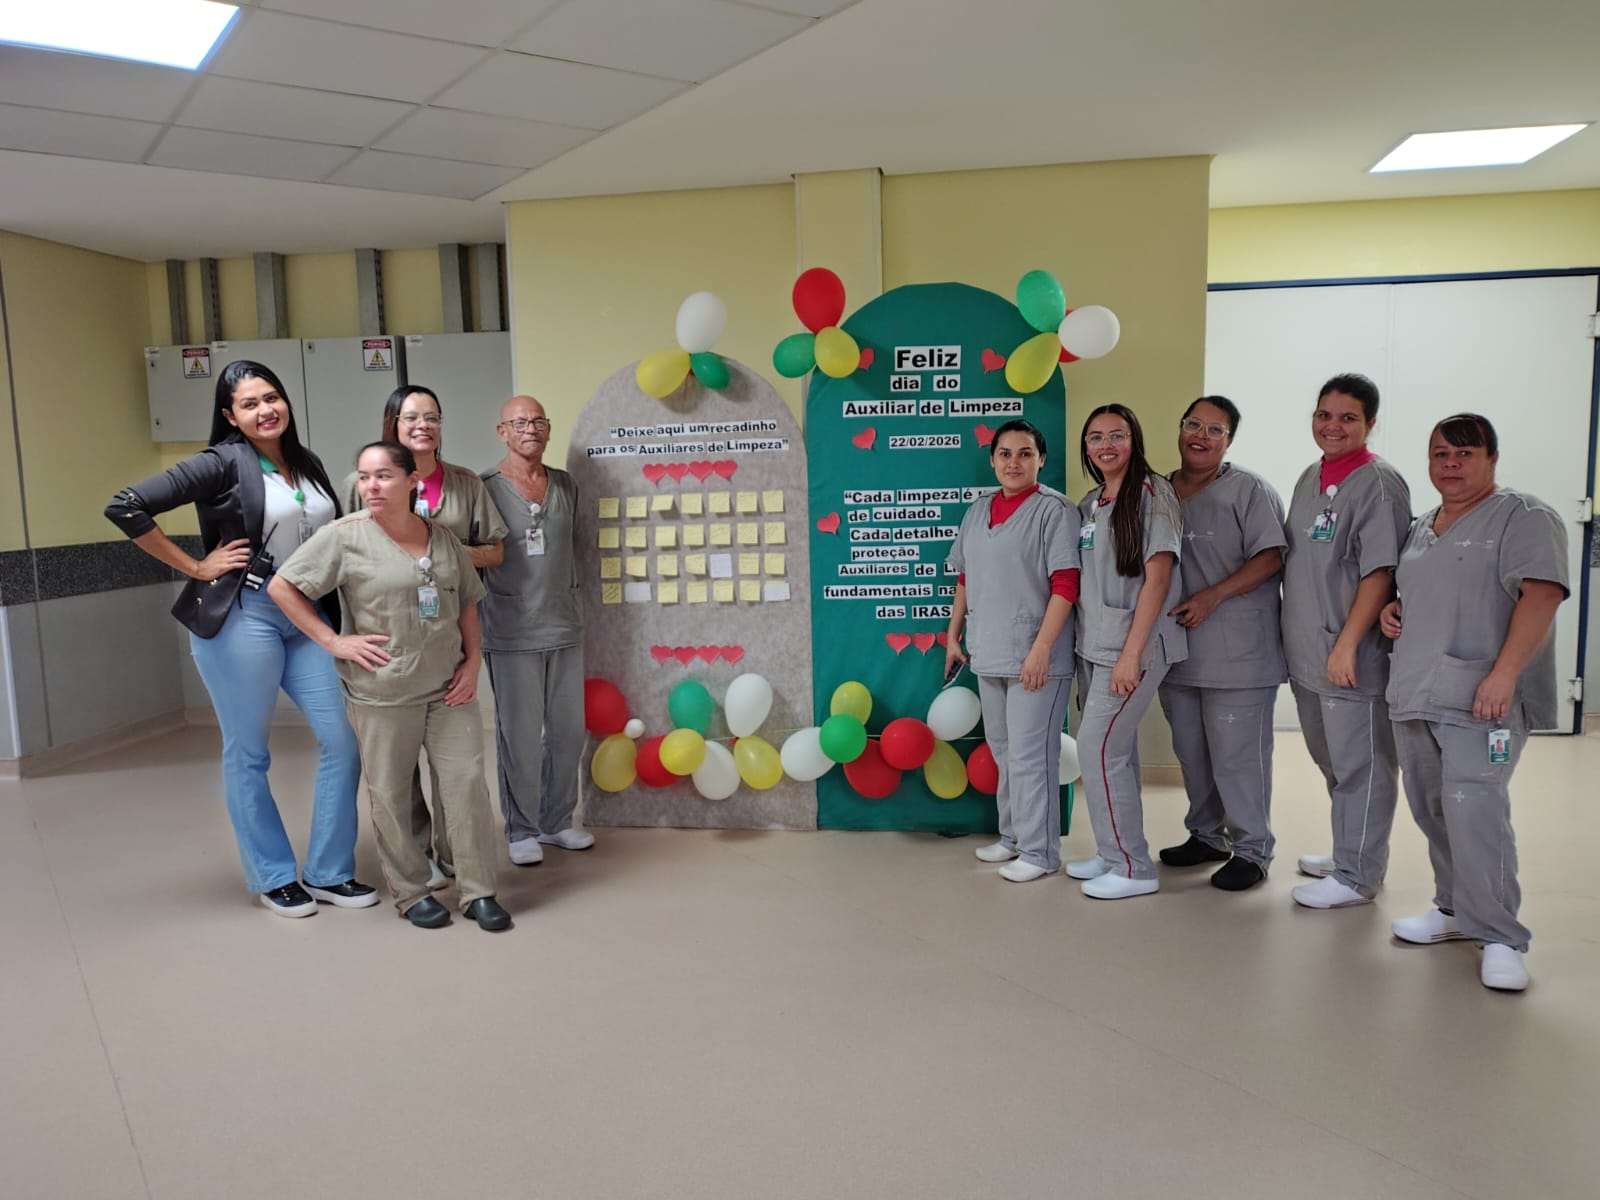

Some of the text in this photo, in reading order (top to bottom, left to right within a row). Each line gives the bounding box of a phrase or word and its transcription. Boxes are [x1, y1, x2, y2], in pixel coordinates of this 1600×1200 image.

[896, 349, 958, 368] Feliz
[892, 376, 959, 390] dia do
[845, 400, 1022, 415] Auxiliar de Limpeza
[610, 427, 654, 437] “Deixe
[657, 423, 685, 435] aqui
[587, 440, 789, 457] para os Auxiliares de Limpeza”
[890, 436, 960, 447] 22/02/2026
[844, 491, 892, 503] “Cada
[897, 489, 959, 503] limpeza
[963, 489, 972, 499] é
[849, 508, 941, 521] de cuidado.
[850, 527, 958, 541] Cada detalhe.
[852, 546, 920, 560] proteção.
[839, 564, 907, 575] Auxiliares
[915, 564, 935, 576] de
[824, 586, 931, 597] fundamentais
[877, 606, 951, 618] das IRAS
